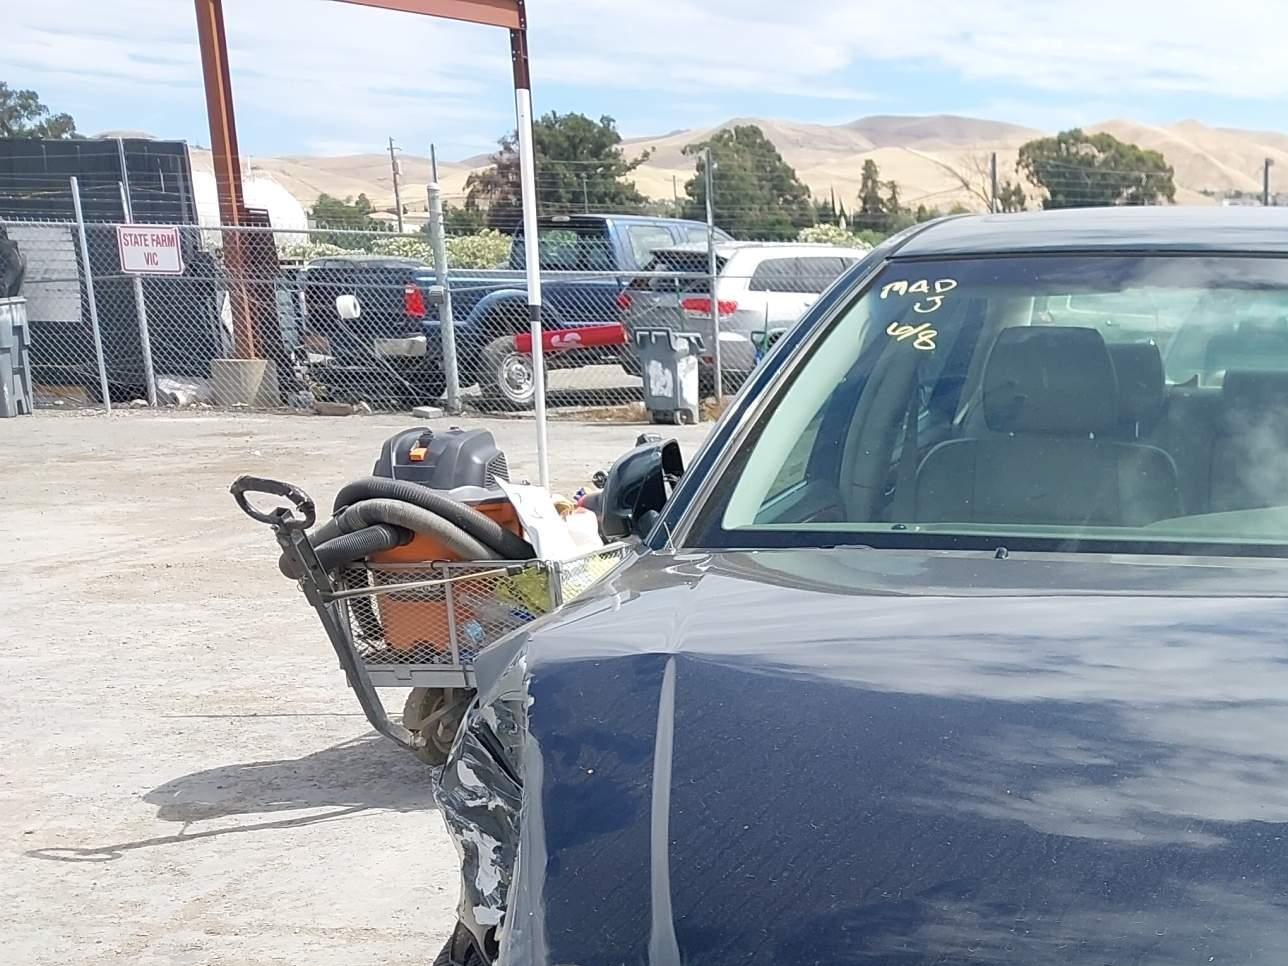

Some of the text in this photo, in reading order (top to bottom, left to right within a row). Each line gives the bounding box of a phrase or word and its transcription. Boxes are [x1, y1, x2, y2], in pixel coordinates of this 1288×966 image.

[123, 233, 176, 248] STATE FARM
[144, 252, 159, 266] VIC
[880, 279, 957, 299] MAD
[886, 321, 938, 350] 6/8
